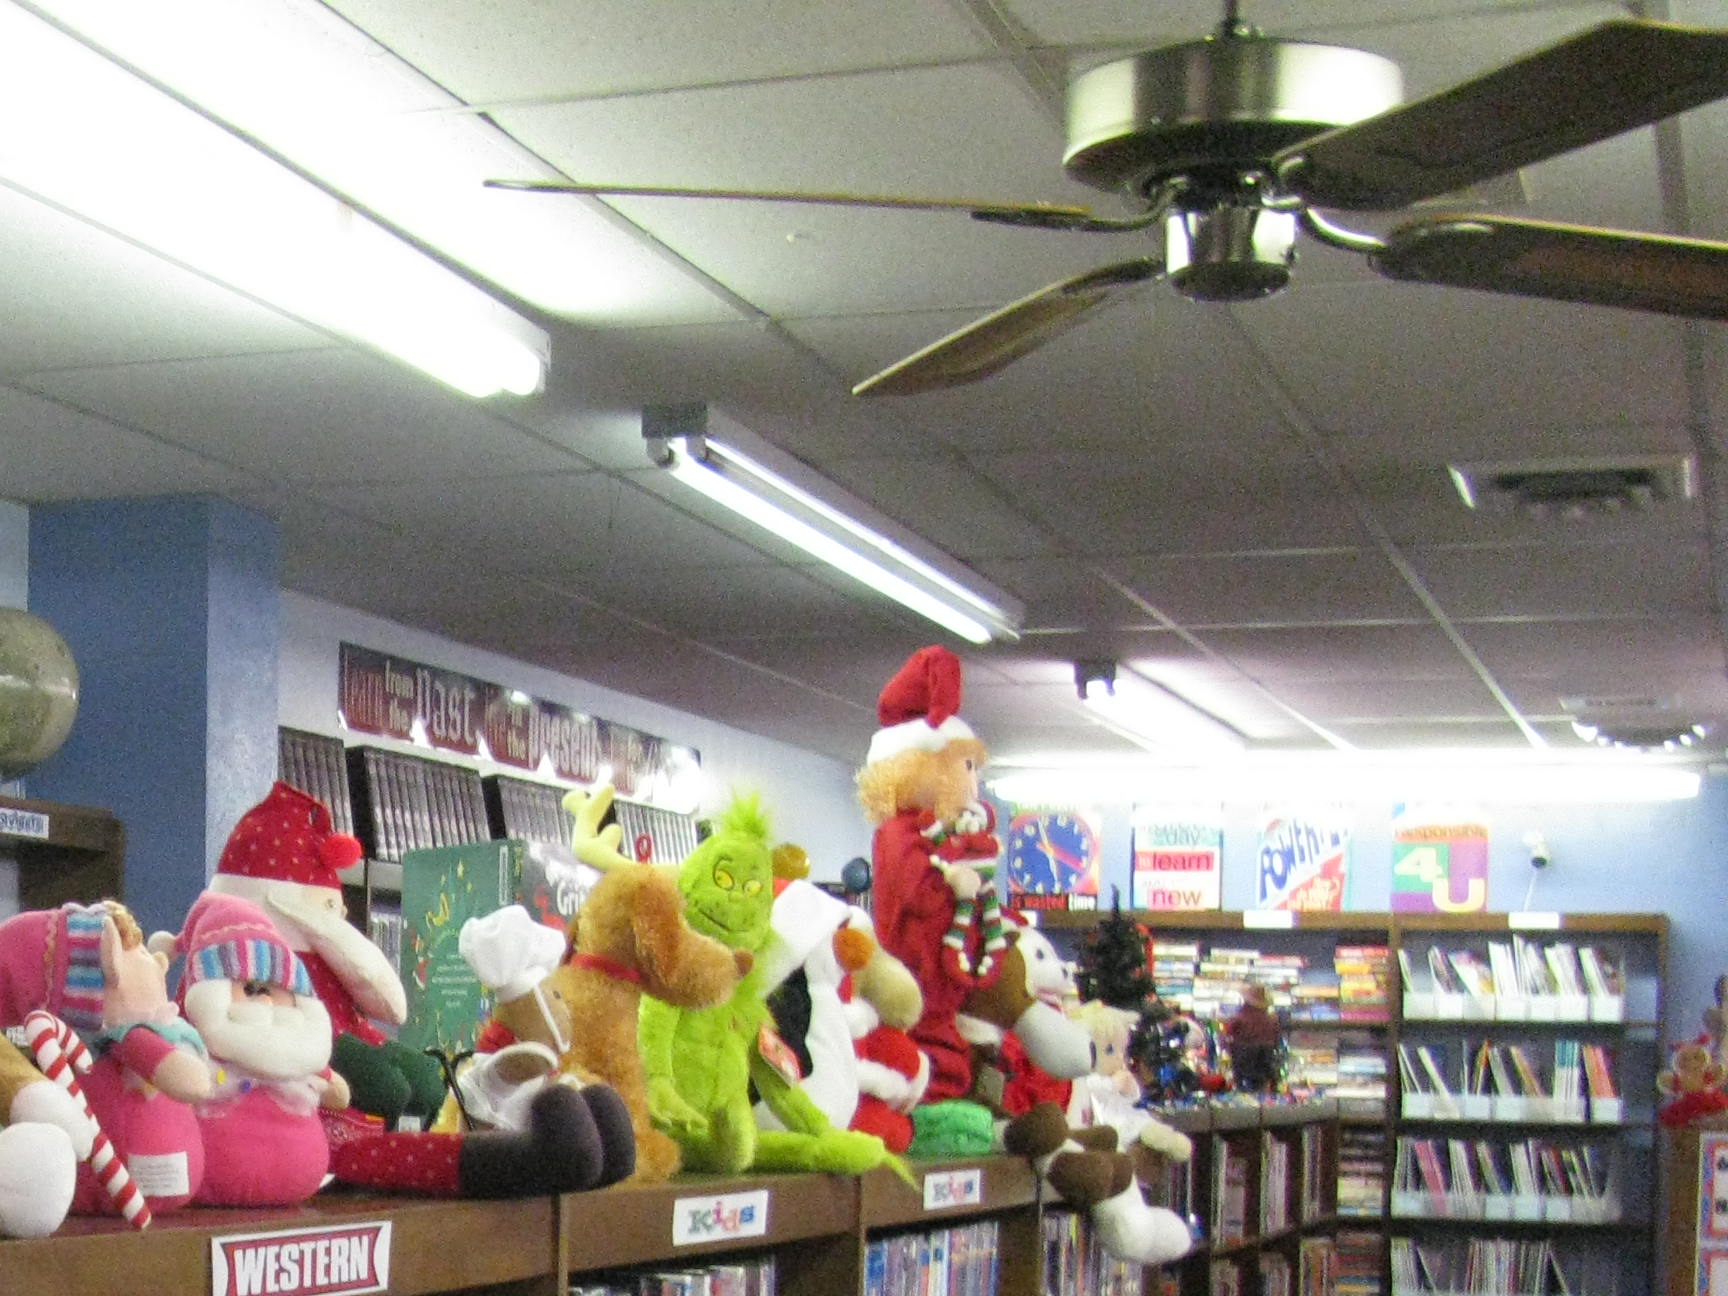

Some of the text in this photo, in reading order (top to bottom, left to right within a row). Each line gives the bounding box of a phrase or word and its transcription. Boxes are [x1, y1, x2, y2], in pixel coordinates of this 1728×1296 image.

[1152, 851, 1211, 871] learn
[1394, 846, 1444, 883] 4
[1431, 877, 1486, 913] U
[687, 1199, 756, 1236] Kids
